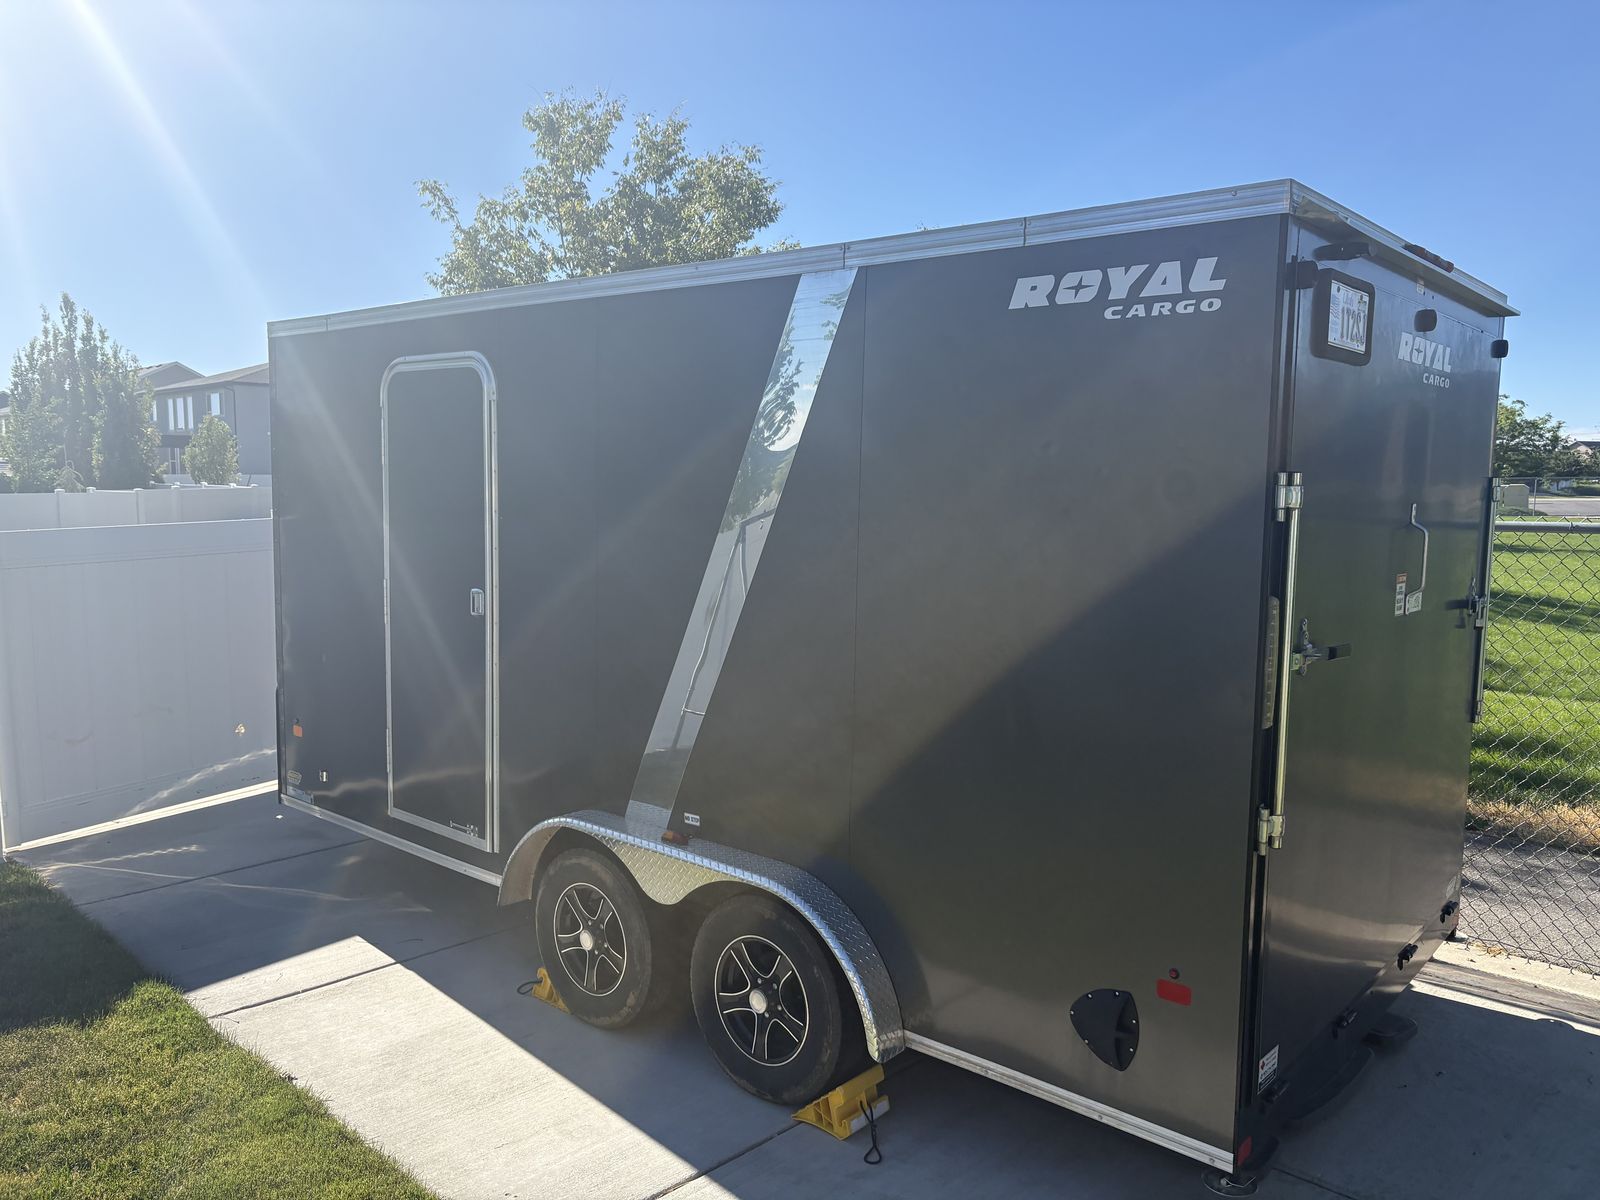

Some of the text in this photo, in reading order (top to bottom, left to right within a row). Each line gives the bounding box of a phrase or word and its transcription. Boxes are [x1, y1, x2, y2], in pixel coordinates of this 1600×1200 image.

[1008, 256, 1227, 310] ROYAL
[1104, 297, 1222, 320] CARGO
[1397, 331, 1452, 373] ROYAL
[1422, 372, 1450, 389] CARGO
